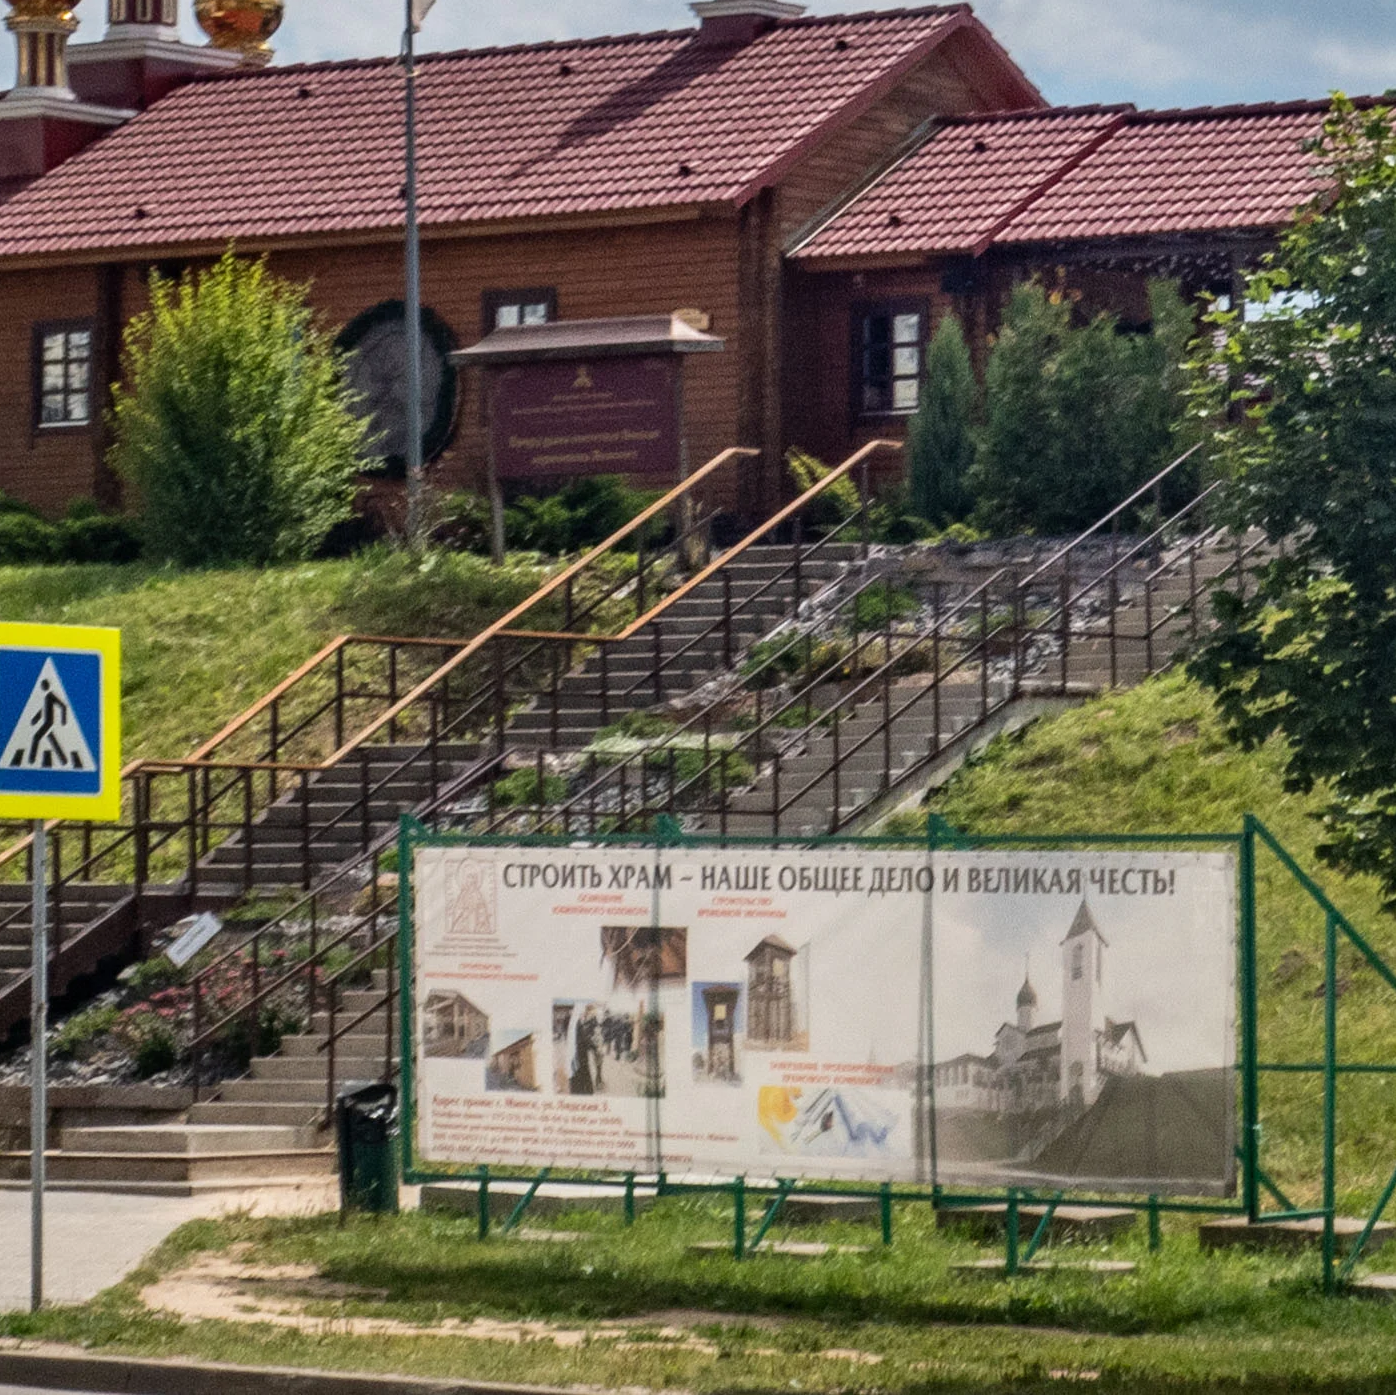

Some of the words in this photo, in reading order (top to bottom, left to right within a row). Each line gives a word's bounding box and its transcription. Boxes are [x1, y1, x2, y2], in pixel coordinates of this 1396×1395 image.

[502, 863, 603, 889] СТРОИТЬ
[608, 864, 673, 890] ХРАМ
[701, 865, 771, 891] НАШЕ
[778, 865, 864, 898] ОБЩЕЕ
[868, 866, 935, 898] ДЕЛО
[943, 867, 959, 894] И
[967, 867, 1082, 895] ВЕЛИКАЯ
[1089, 867, 1176, 896] ЧЕСТЬ!
